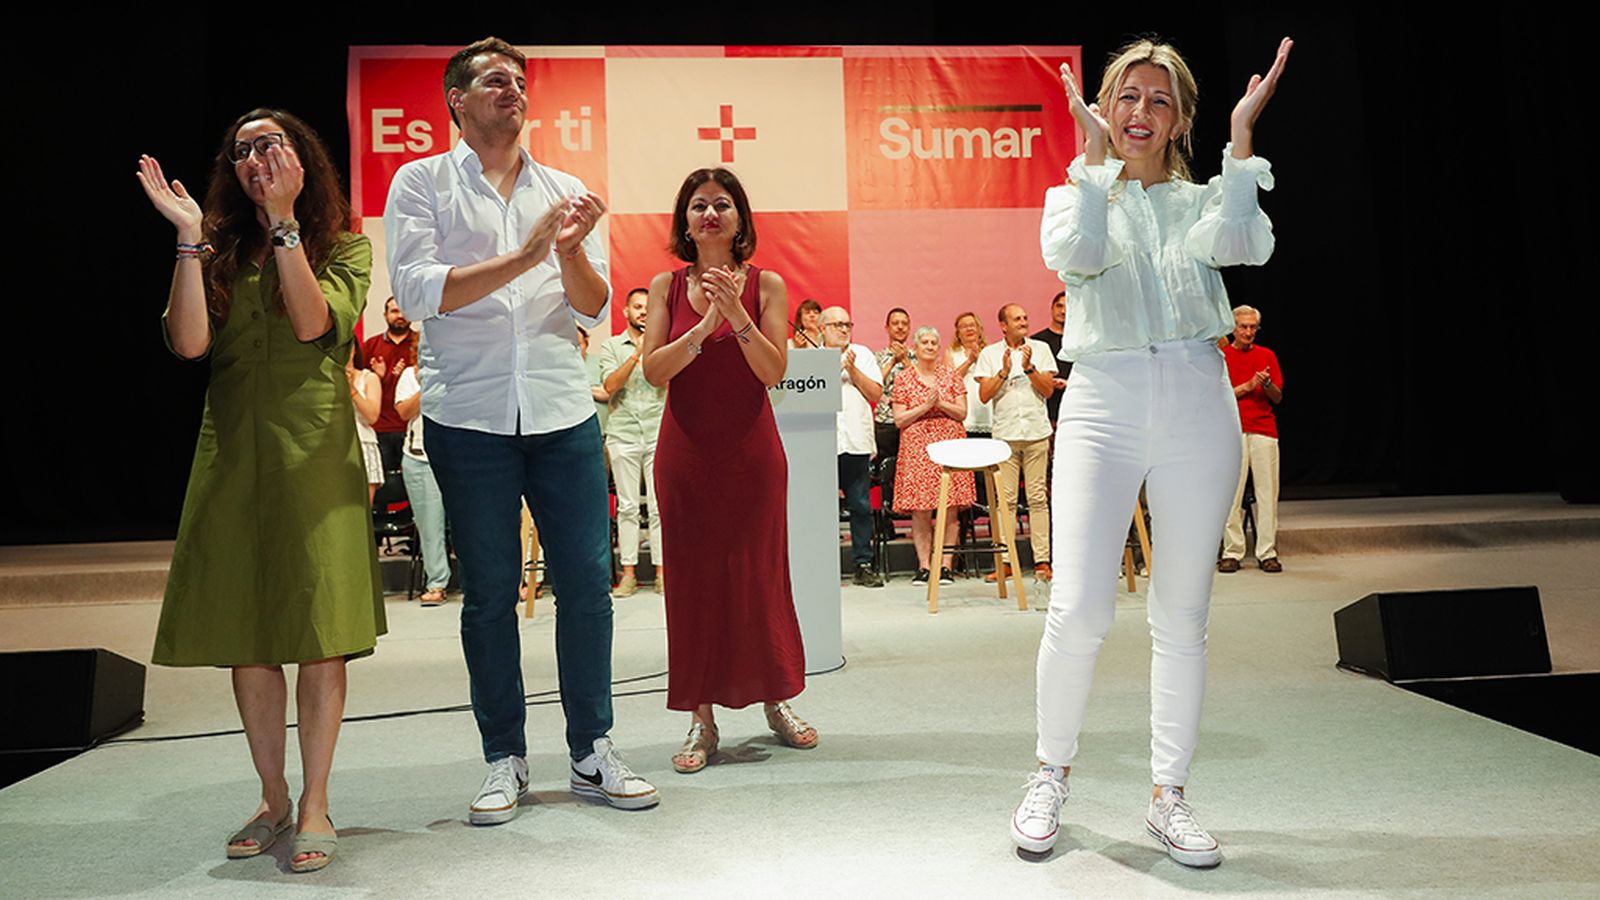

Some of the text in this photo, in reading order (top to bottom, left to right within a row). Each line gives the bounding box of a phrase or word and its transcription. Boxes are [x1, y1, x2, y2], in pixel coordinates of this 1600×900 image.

[371, 108, 433, 153] Es
[554, 106, 592, 151] ti
[879, 117, 1042, 160] Sumar
[767, 375, 826, 393] ragón
